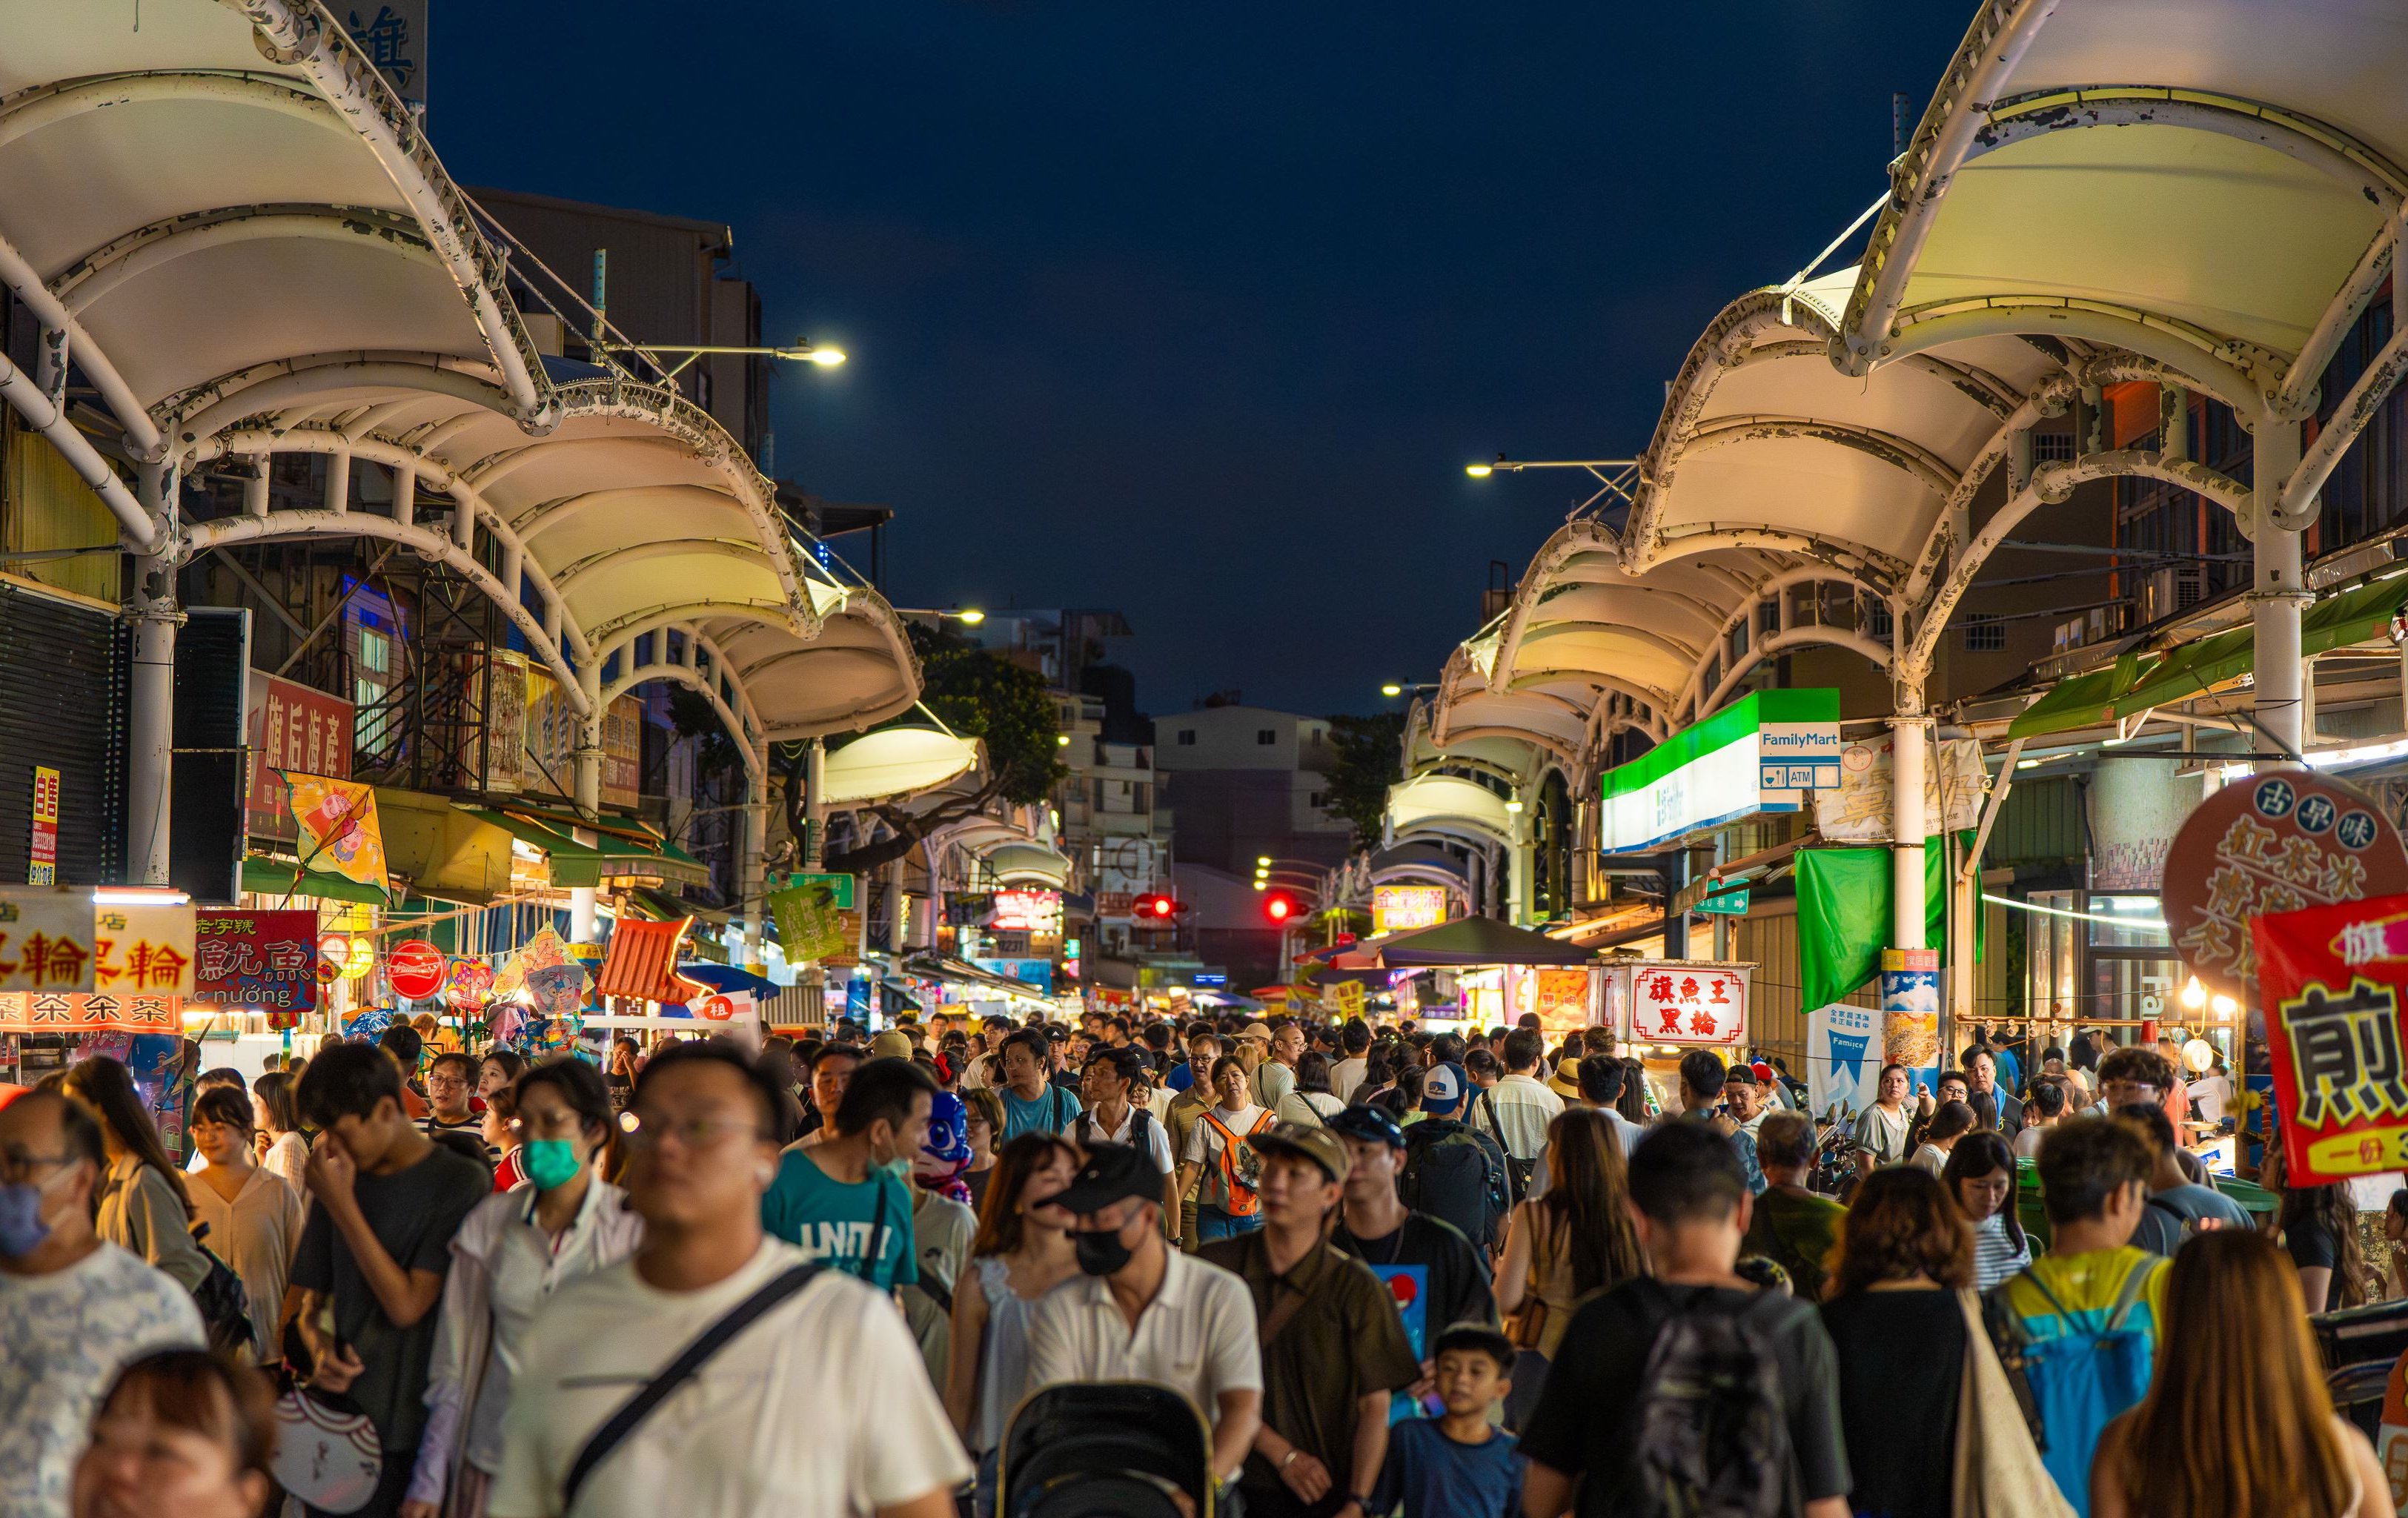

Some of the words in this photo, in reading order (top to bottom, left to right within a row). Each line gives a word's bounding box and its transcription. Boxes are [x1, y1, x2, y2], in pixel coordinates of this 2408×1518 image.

[266, 694, 339, 775] 旗后海產
[1762, 732, 1837, 748] FamilyMart
[1791, 772, 1810, 782] ATM
[36, 772, 58, 817] 自售
[264, 784, 273, 804] TEL
[2263, 783, 2370, 847] 古早味
[2217, 814, 2366, 901] 紅茶冰
[197, 938, 311, 981] 魷魚
[213, 985, 291, 1007] nướng
[1648, 975, 1731, 1005] 旗魚王
[2142, 975, 2172, 1020] Fa
[710, 1002, 729, 1016] 租
[1659, 1008, 1718, 1036] 黑輪
[2281, 977, 2408, 1125] 煎
[2329, 1138, 2384, 1166] 一份
